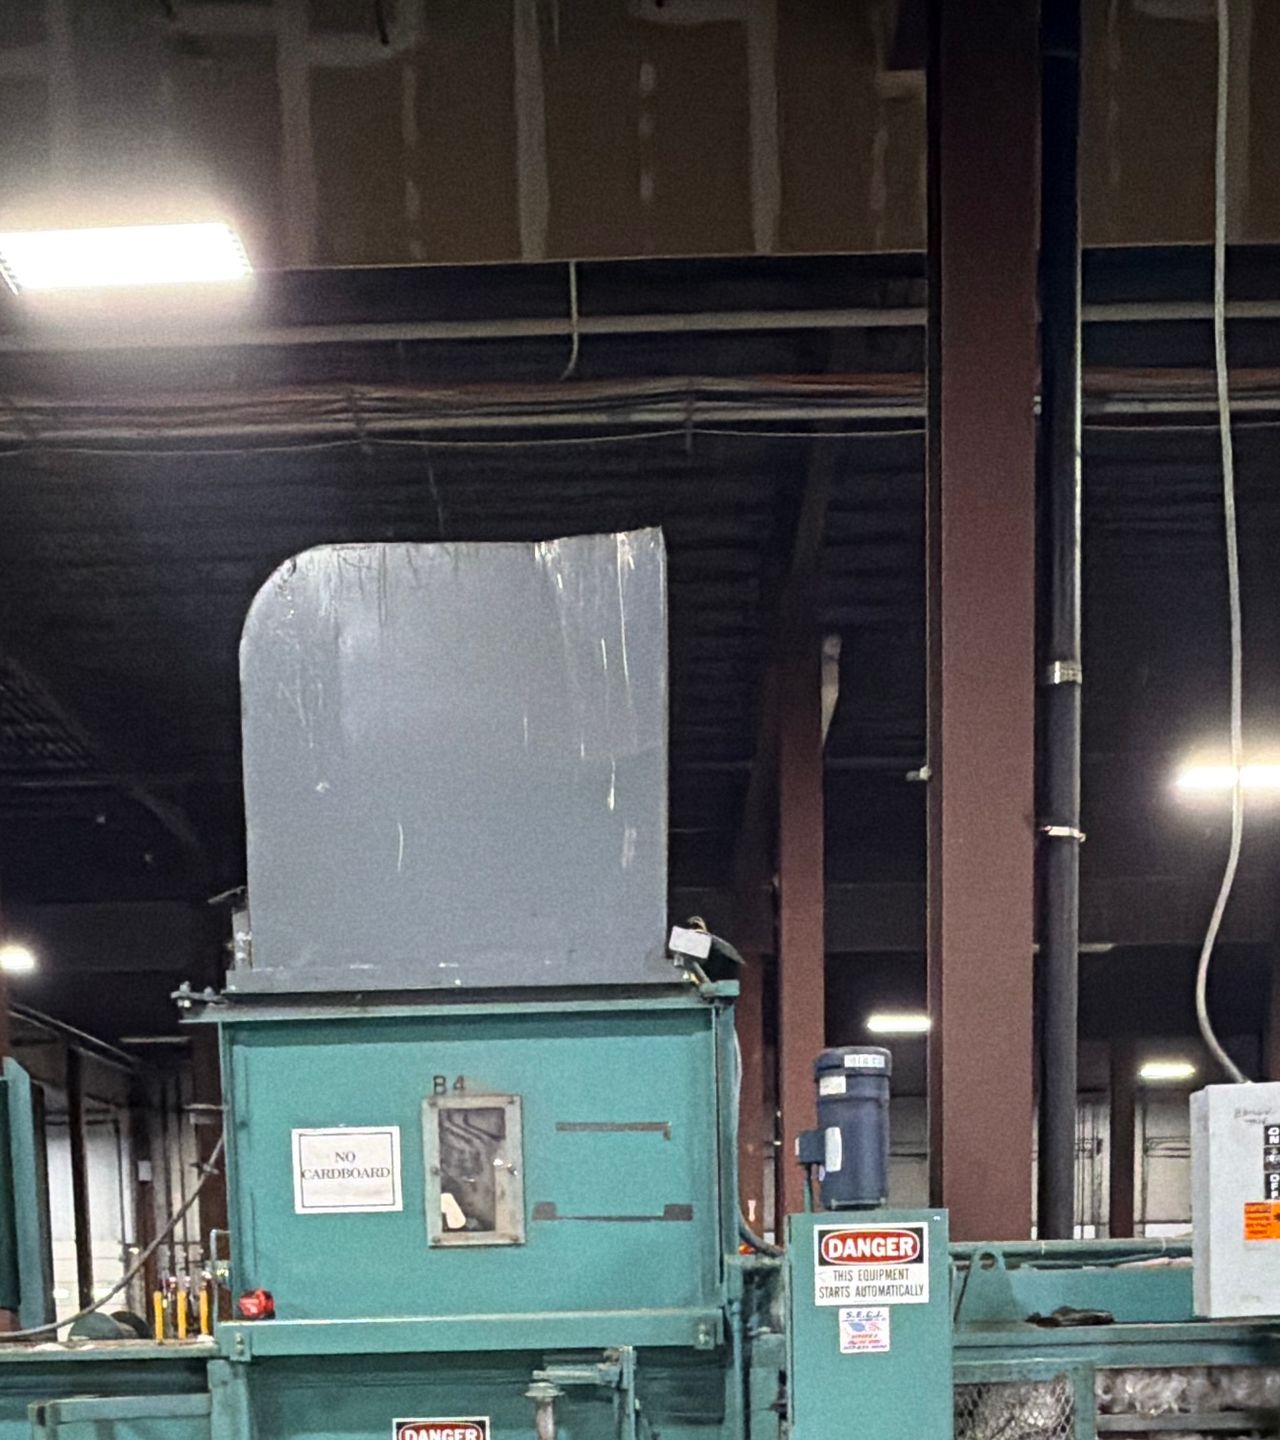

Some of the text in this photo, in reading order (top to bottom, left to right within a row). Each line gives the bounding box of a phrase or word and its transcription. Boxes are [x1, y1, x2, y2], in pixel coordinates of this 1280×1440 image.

[1268, 1127, 1280, 1145] ON
[334, 1151, 356, 1164] NO
[302, 1167, 390, 1181] CARDBOARD
[827, 1237, 915, 1258] DANGER
[833, 1268, 909, 1282] THIS EQUIPMENT
[819, 1284, 924, 1299] STARTS AUTOMATICALLY
